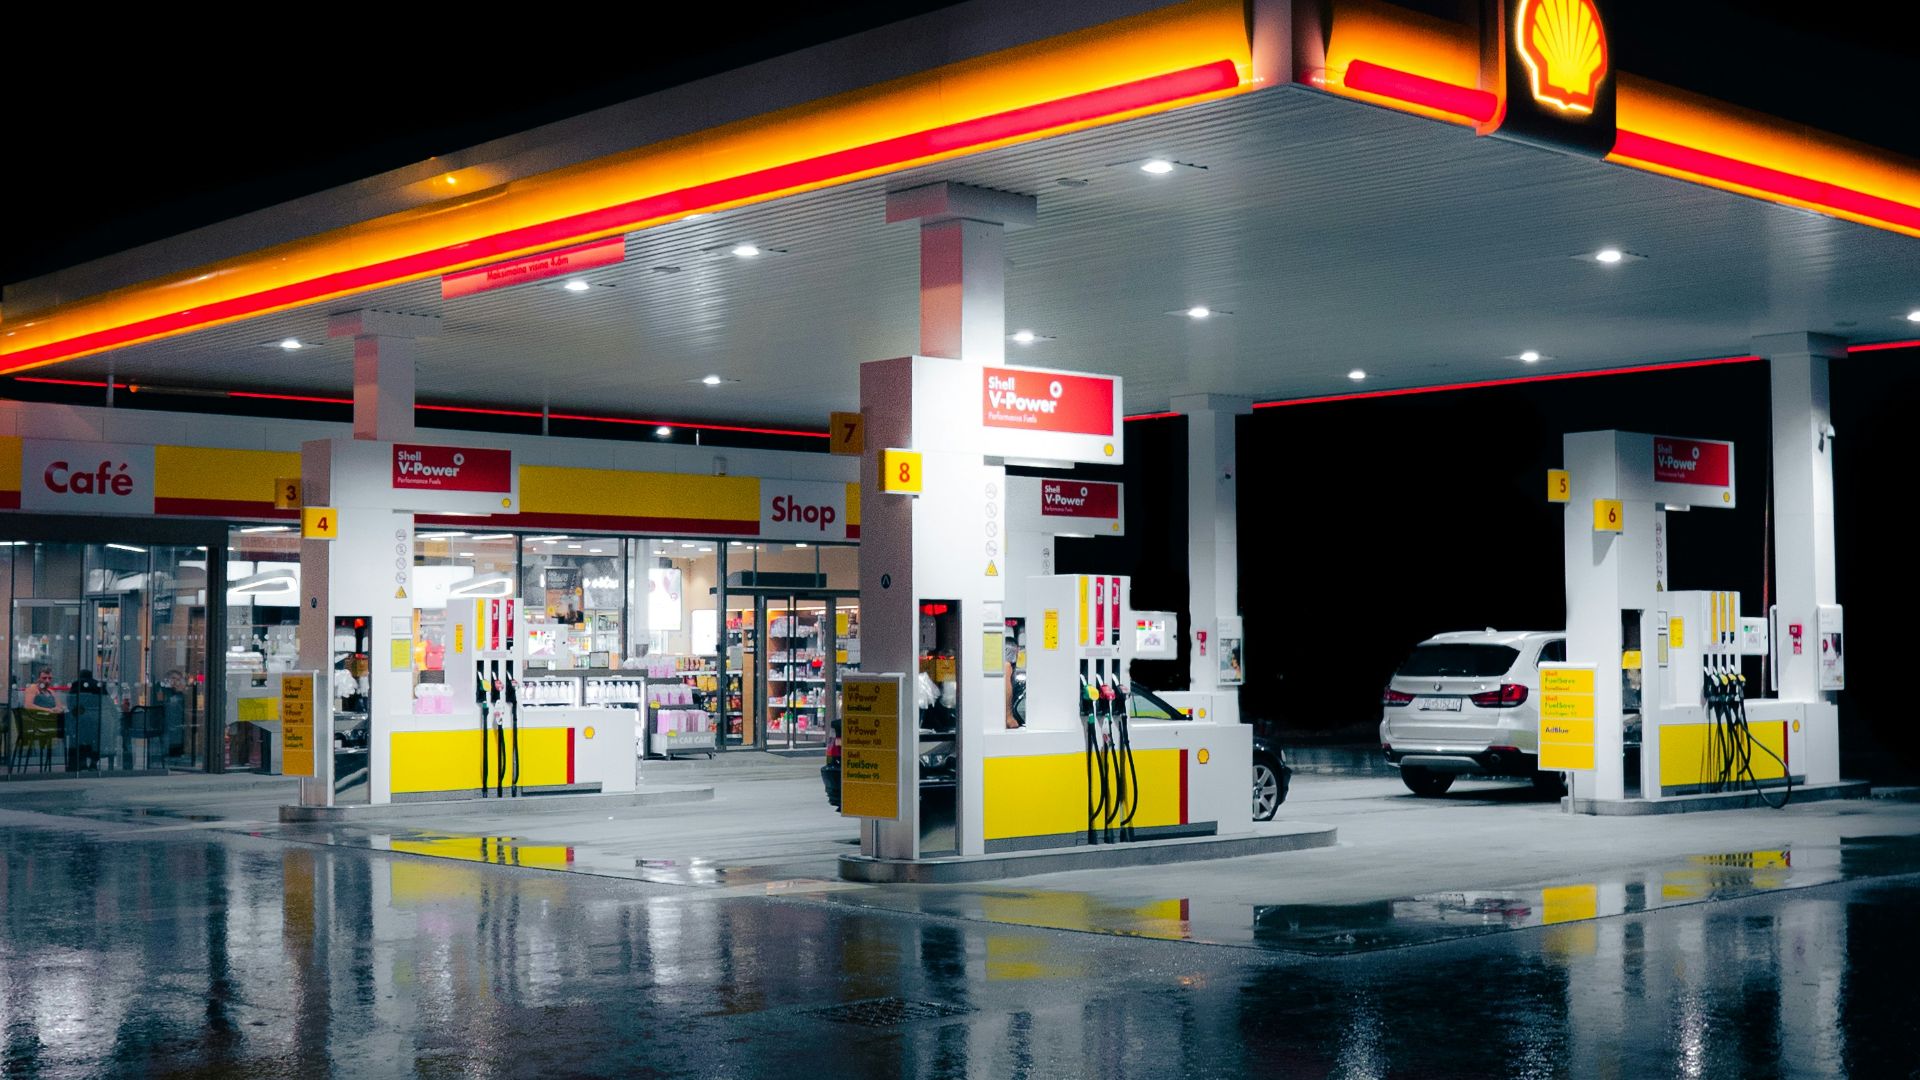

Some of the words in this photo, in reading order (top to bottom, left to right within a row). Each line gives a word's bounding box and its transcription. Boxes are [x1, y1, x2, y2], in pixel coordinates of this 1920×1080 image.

[988, 376, 1015, 390] Shell
[989, 390, 1057, 414] V-Power
[988, 412, 1023, 422] Performance
[1024, 414, 1038, 424] Fuels
[844, 424, 857, 443] 7
[398, 451, 421, 461] Shell
[1658, 444, 1673, 454] Shell
[399, 462, 460, 477] V-Power
[1658, 456, 1697, 471] V-Power
[44, 461, 133, 496] Café
[899, 463, 910, 483] 8
[398, 477, 428, 485] Performance
[1560, 479, 1566, 493] 5
[286, 486, 297, 501] 3
[1045, 485, 1060, 493] Shell
[1045, 494, 1085, 506] V-Power
[771, 495, 836, 531] Shop
[1609, 508, 1616, 523] 6
[317, 517, 329, 532] 4
[848, 693, 877, 702] V-Power
[848, 726, 877, 736] V-Power
[847, 760, 879, 770] FuelSave
